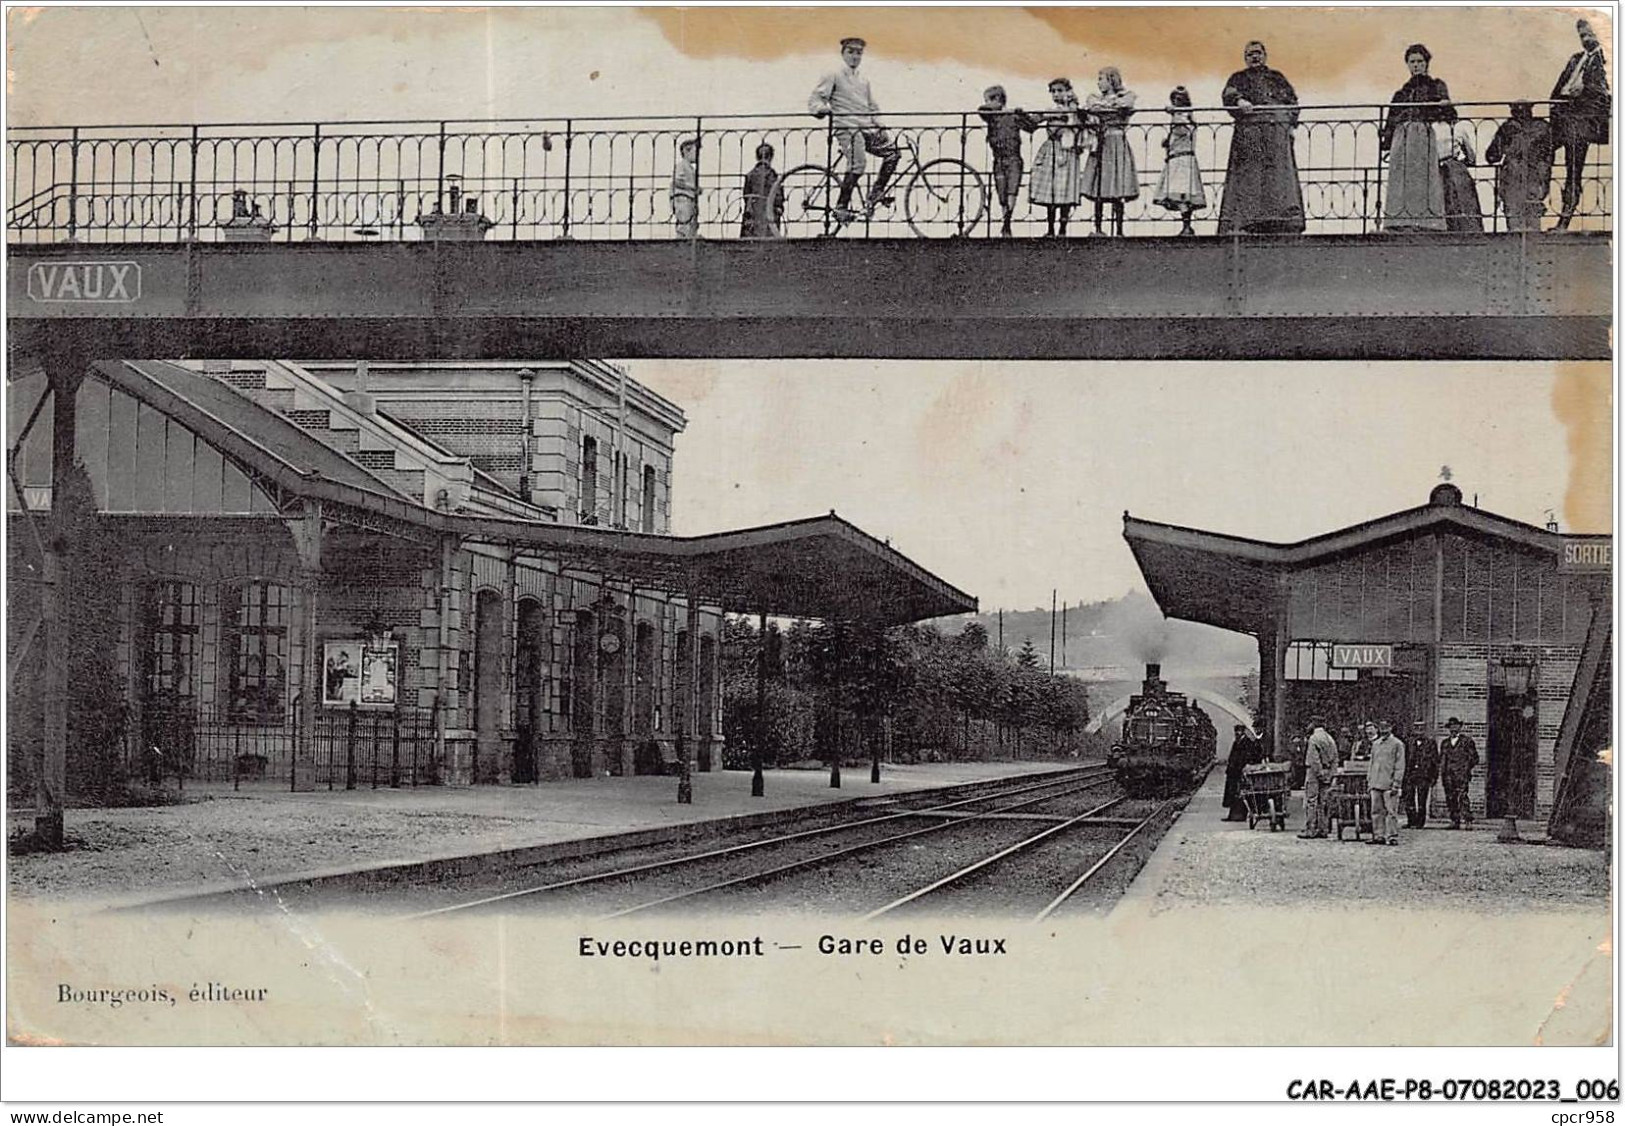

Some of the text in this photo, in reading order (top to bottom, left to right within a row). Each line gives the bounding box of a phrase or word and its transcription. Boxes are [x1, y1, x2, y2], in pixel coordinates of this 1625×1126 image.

[38, 265, 130, 299] VAUX
[1565, 543, 1611, 565] SORTIE
[1340, 648, 1385, 664] VAUX
